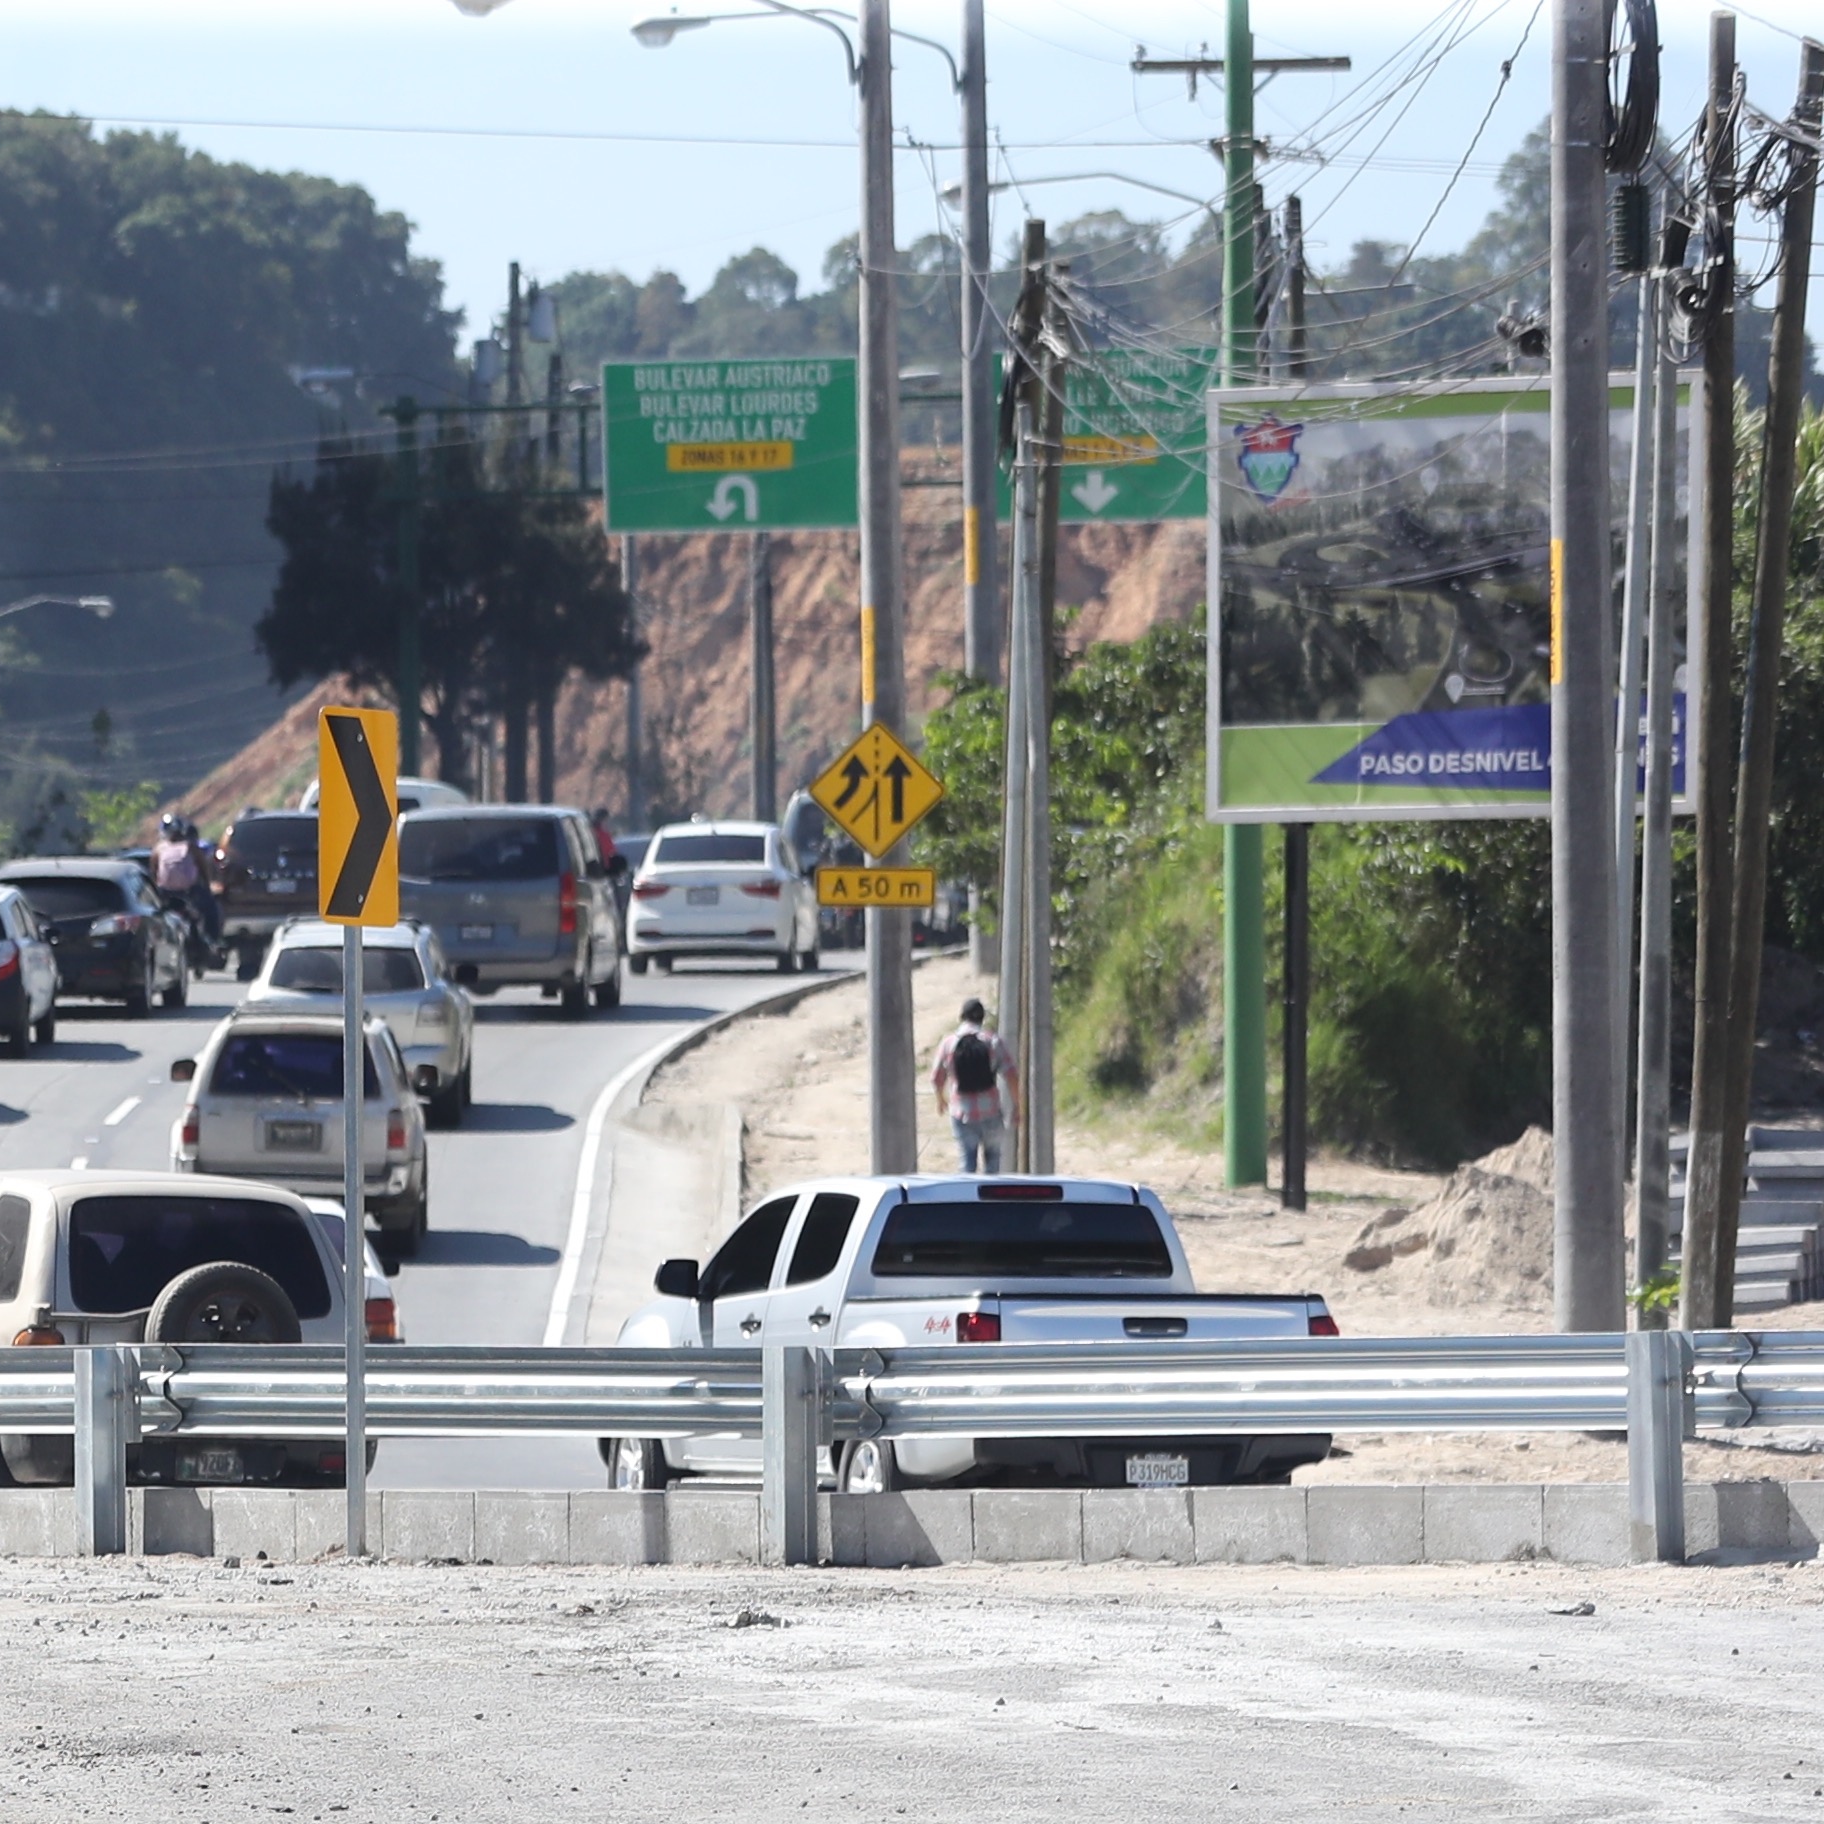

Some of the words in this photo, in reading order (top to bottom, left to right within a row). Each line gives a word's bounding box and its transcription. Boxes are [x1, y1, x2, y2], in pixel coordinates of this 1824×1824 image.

[634, 366, 719, 391] BULEVAR
[725, 363, 831, 389] AUSTRIACO
[640, 393, 725, 418] BULEVAR
[731, 390, 819, 416] LOURDES
[653, 419, 737, 443] CALZADA
[743, 418, 767, 441] LA
[771, 418, 806, 441] PAZ
[681, 449, 725, 466] ZONAS
[750, 448, 760, 463] Y
[763, 447, 778, 463] 17
[1360, 753, 1423, 776] PASO
[1428, 751, 1544, 774] DESNIVEL
[832, 877, 848, 898] A
[858, 877, 890, 898] 50
[900, 882, 920, 898] m
